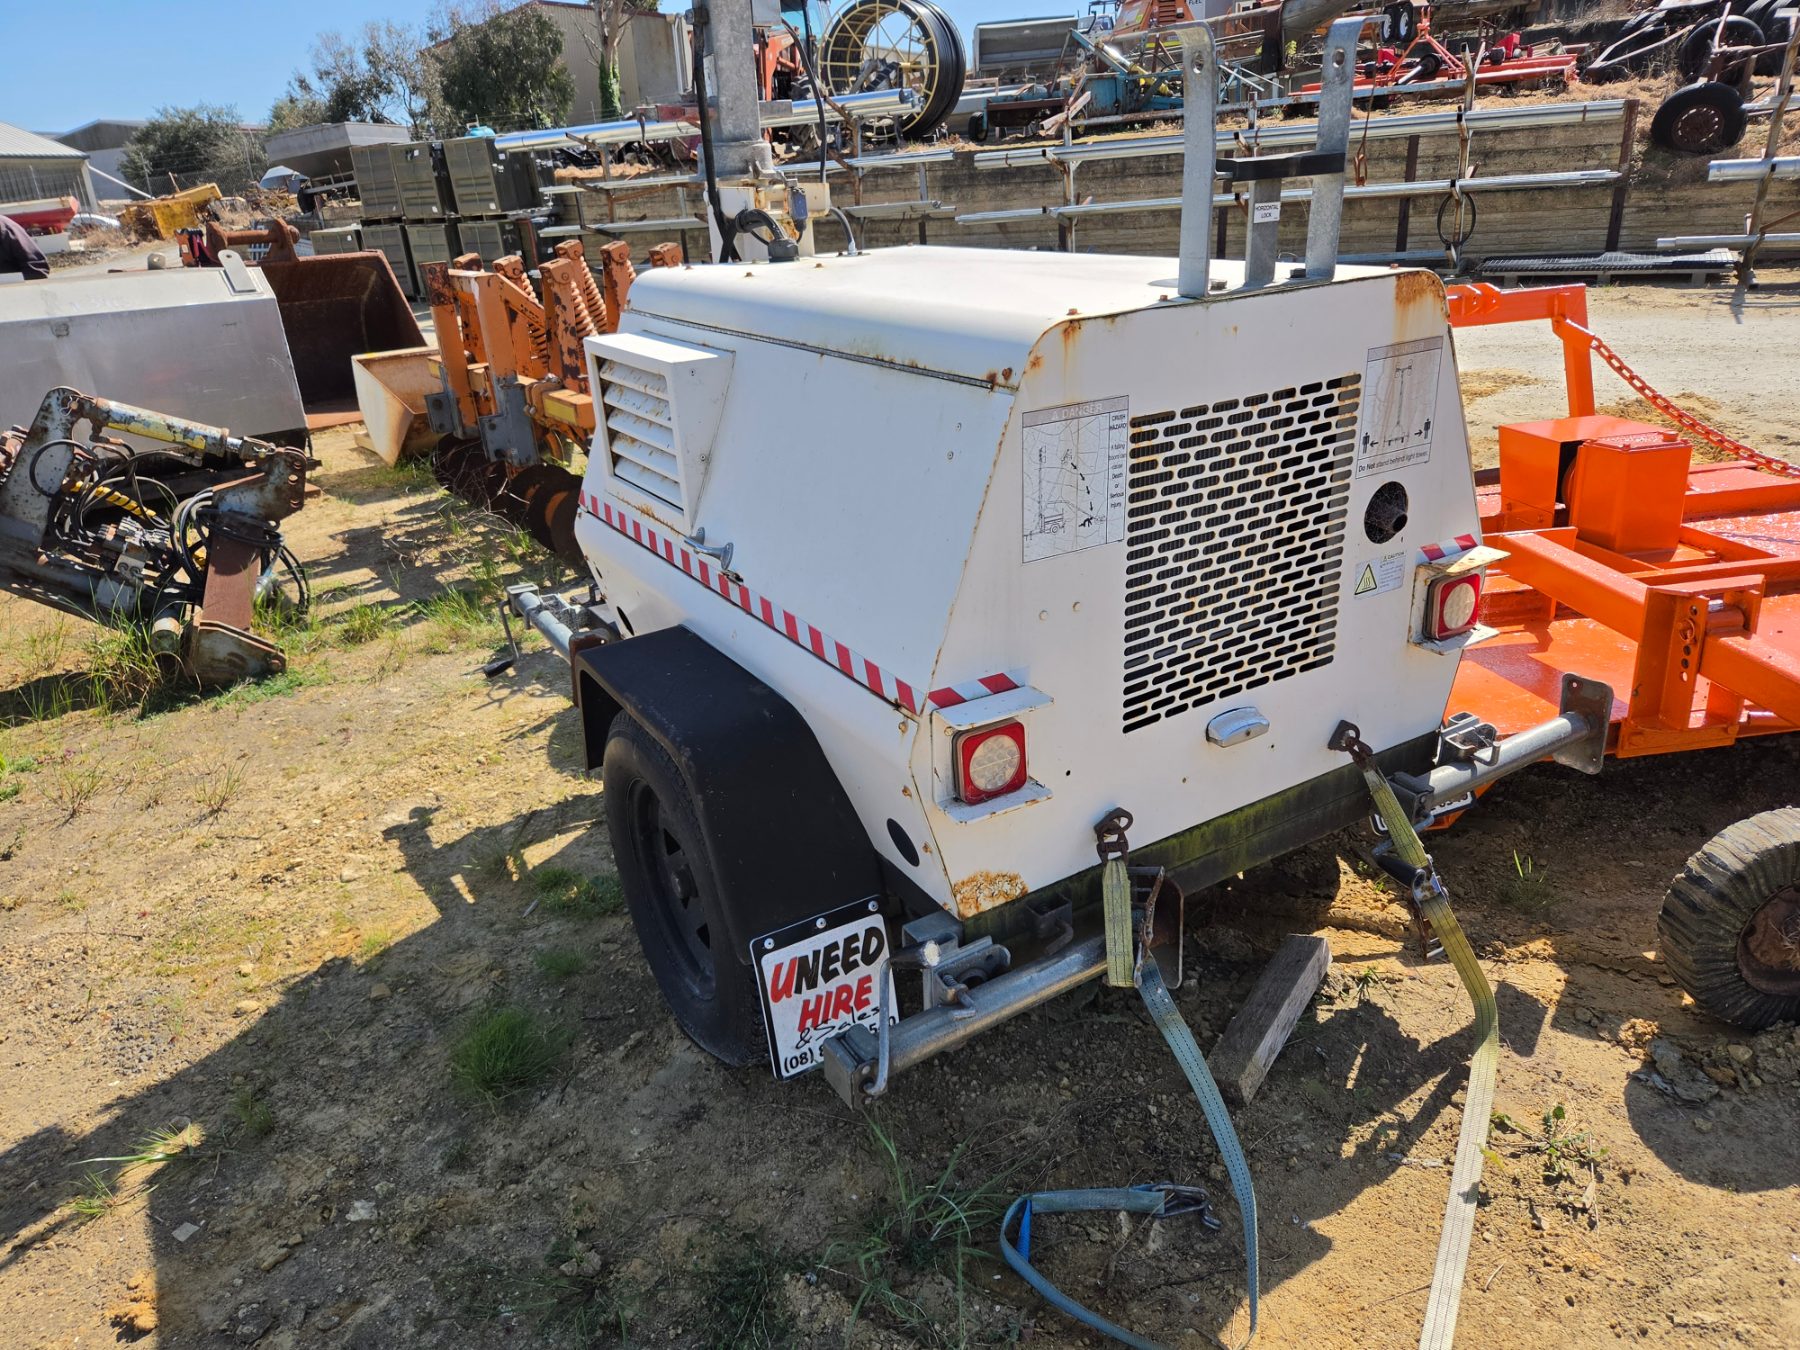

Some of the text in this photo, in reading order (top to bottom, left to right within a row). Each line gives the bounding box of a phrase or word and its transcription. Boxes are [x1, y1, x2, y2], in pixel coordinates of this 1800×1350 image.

[1062, 403, 1103, 418] DANGER
[1358, 464, 1366, 473] Do
[1366, 462, 1376, 471] Not
[769, 926, 886, 1003] UNEED
[797, 974, 874, 1032] HIRE
[795, 1027, 813, 1050] &
[812, 1006, 881, 1042] Sales
[783, 1050, 814, 1073] (08)
